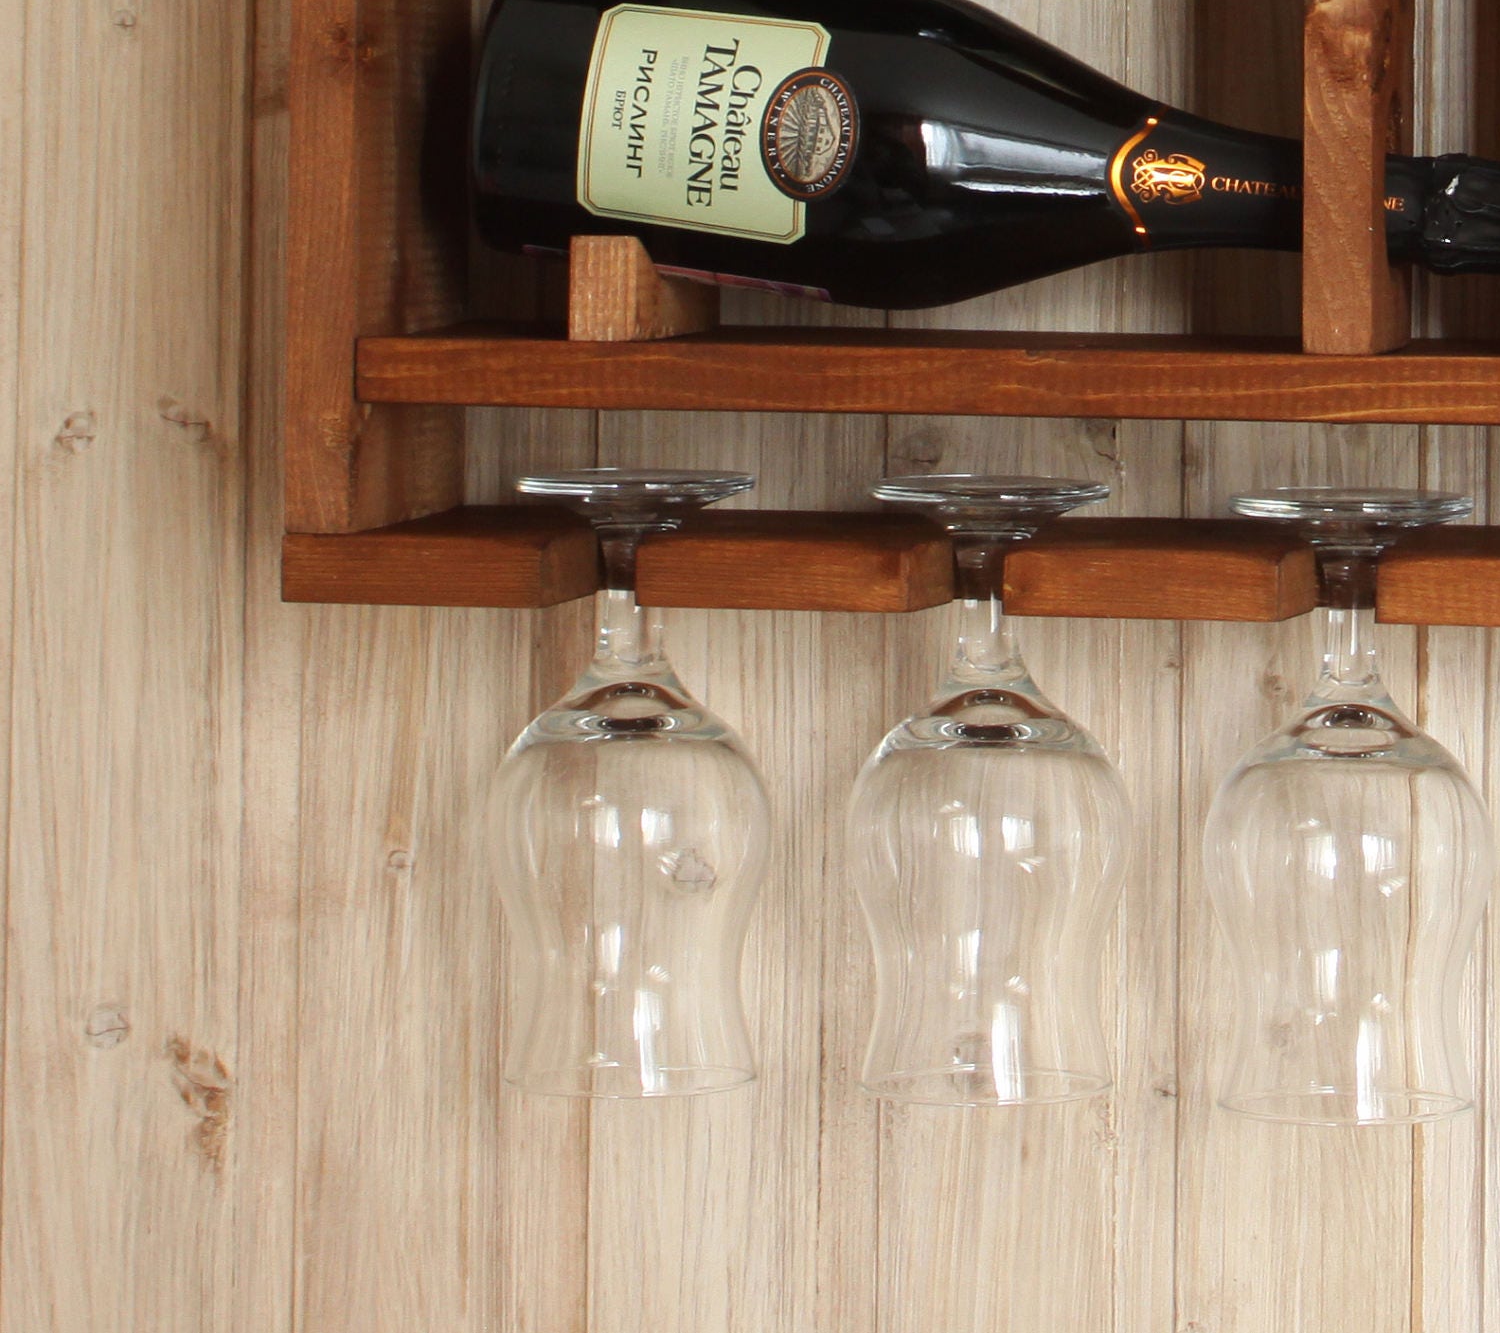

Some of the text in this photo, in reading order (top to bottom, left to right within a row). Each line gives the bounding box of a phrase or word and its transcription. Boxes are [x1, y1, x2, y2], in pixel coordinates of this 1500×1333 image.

[612, 90, 626, 130] БРЮТ
[626, 49, 658, 178] РИСЛИНГ
[686, 38, 740, 207] TAMAGNE
[719, 65, 762, 191] Château
[767, 91, 791, 170] WINERY
[806, 140, 849, 193] TAMAGNE
